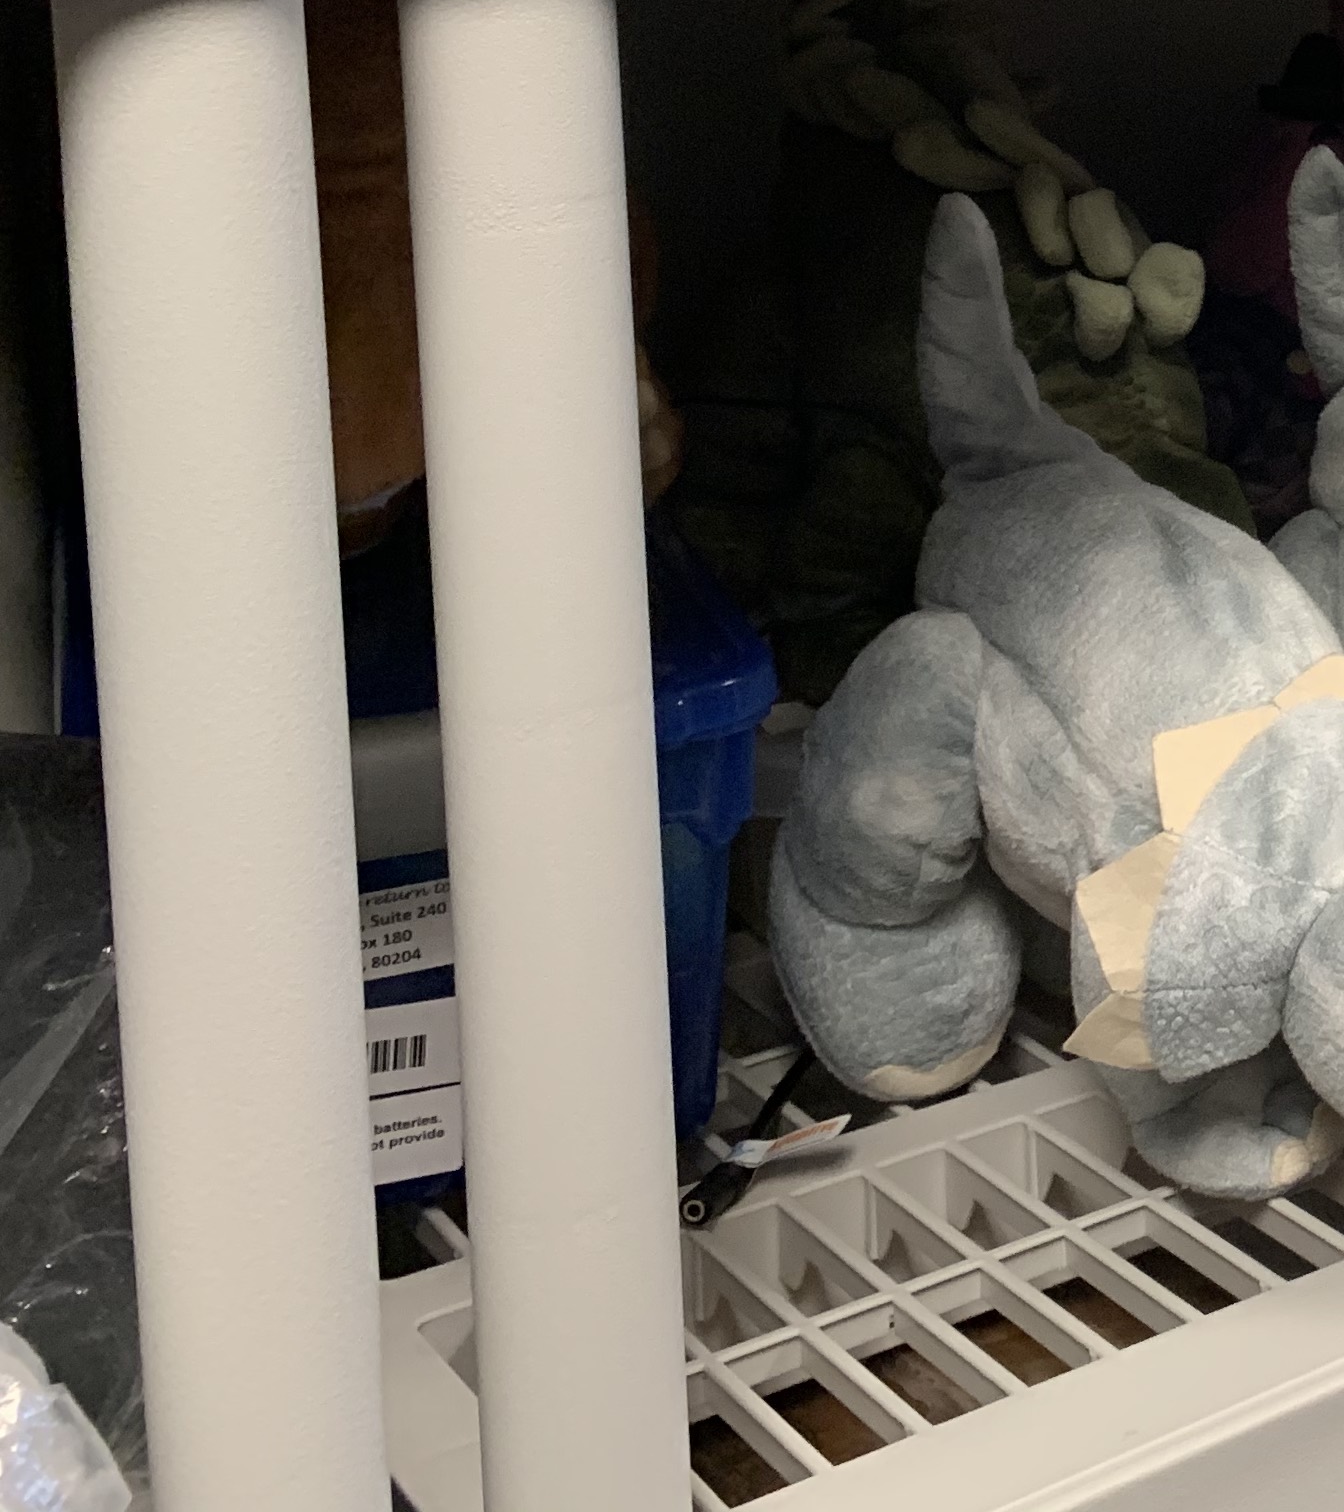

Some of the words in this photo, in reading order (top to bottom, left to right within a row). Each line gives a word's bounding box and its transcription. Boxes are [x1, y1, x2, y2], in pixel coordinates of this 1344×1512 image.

[370, 909, 413, 929] Suite
[416, 900, 447, 921] 240
[383, 929, 413, 947] 180
[371, 947, 422, 970] 80204
[373, 1114, 443, 1136] batteries.
[388, 1128, 445, 1151] provide
